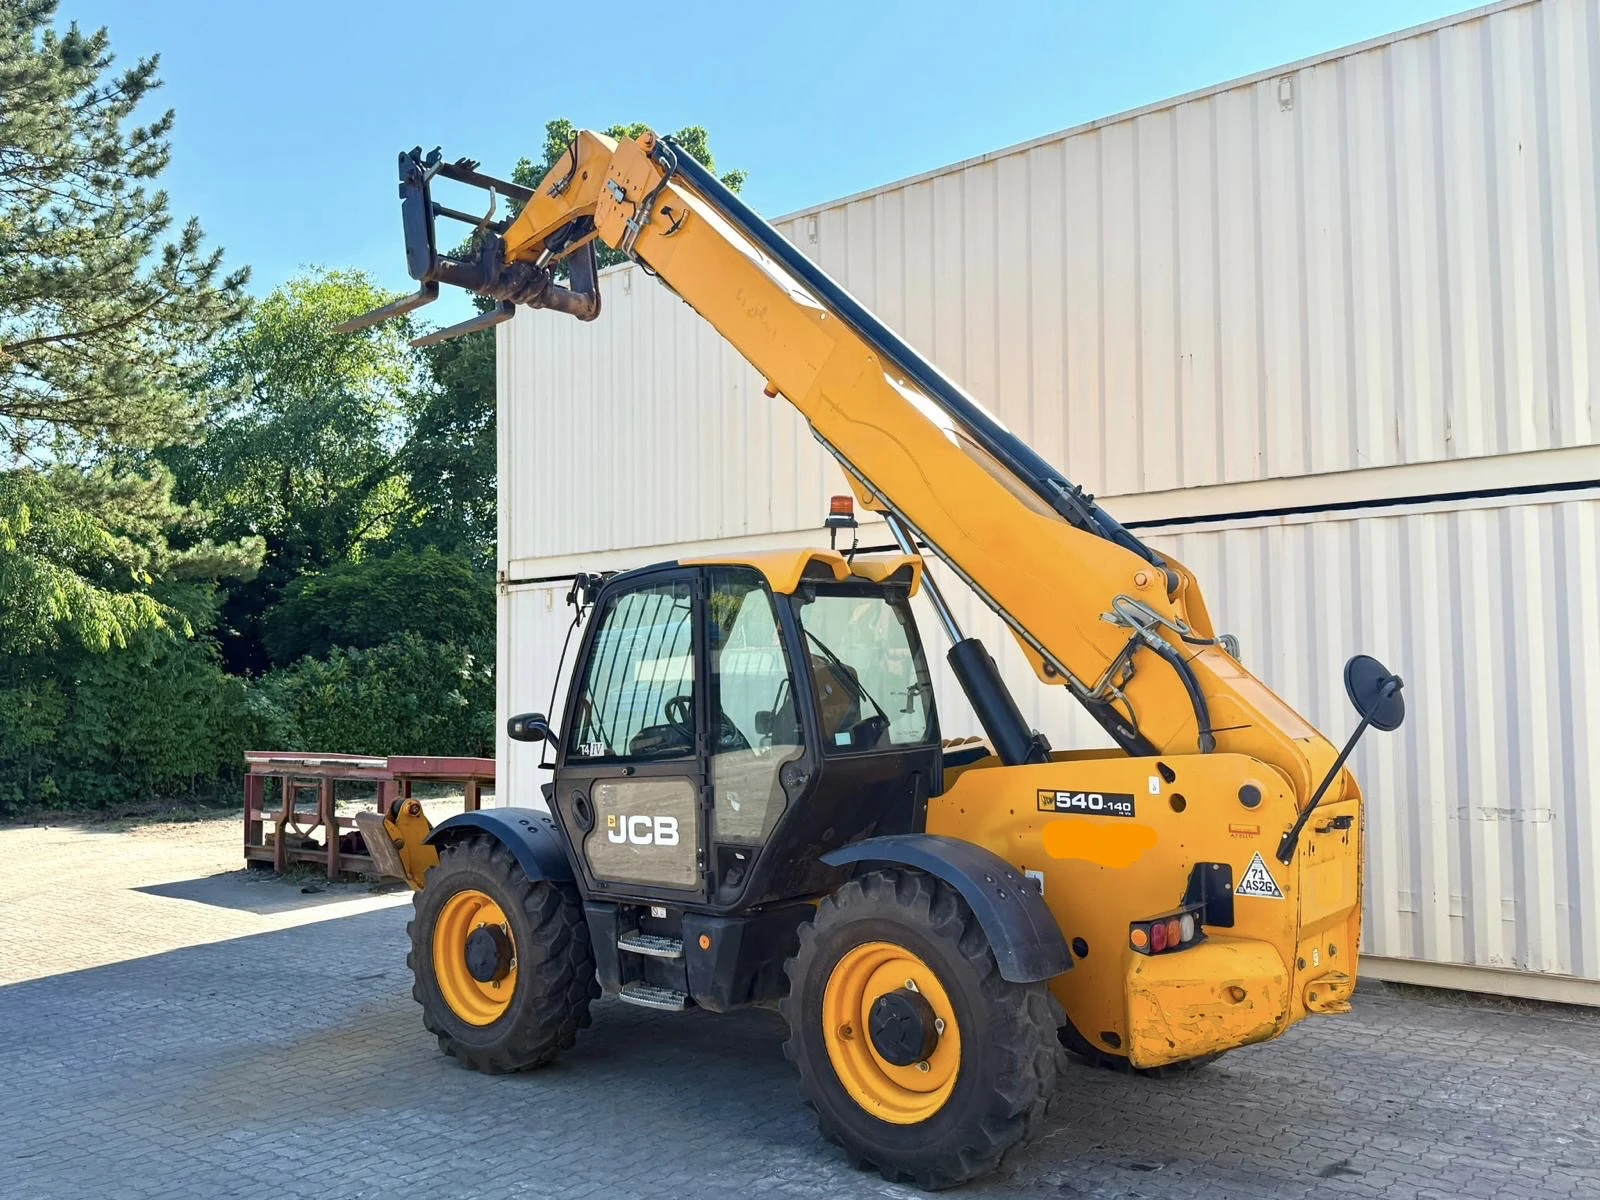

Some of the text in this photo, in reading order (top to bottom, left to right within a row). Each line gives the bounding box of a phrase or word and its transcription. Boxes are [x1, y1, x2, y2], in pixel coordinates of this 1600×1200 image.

[1056, 791, 1131, 811] 540-140
[607, 815, 680, 846] JCB
[1251, 869, 1265, 880] 71
[1245, 879, 1273, 892] AS2G
